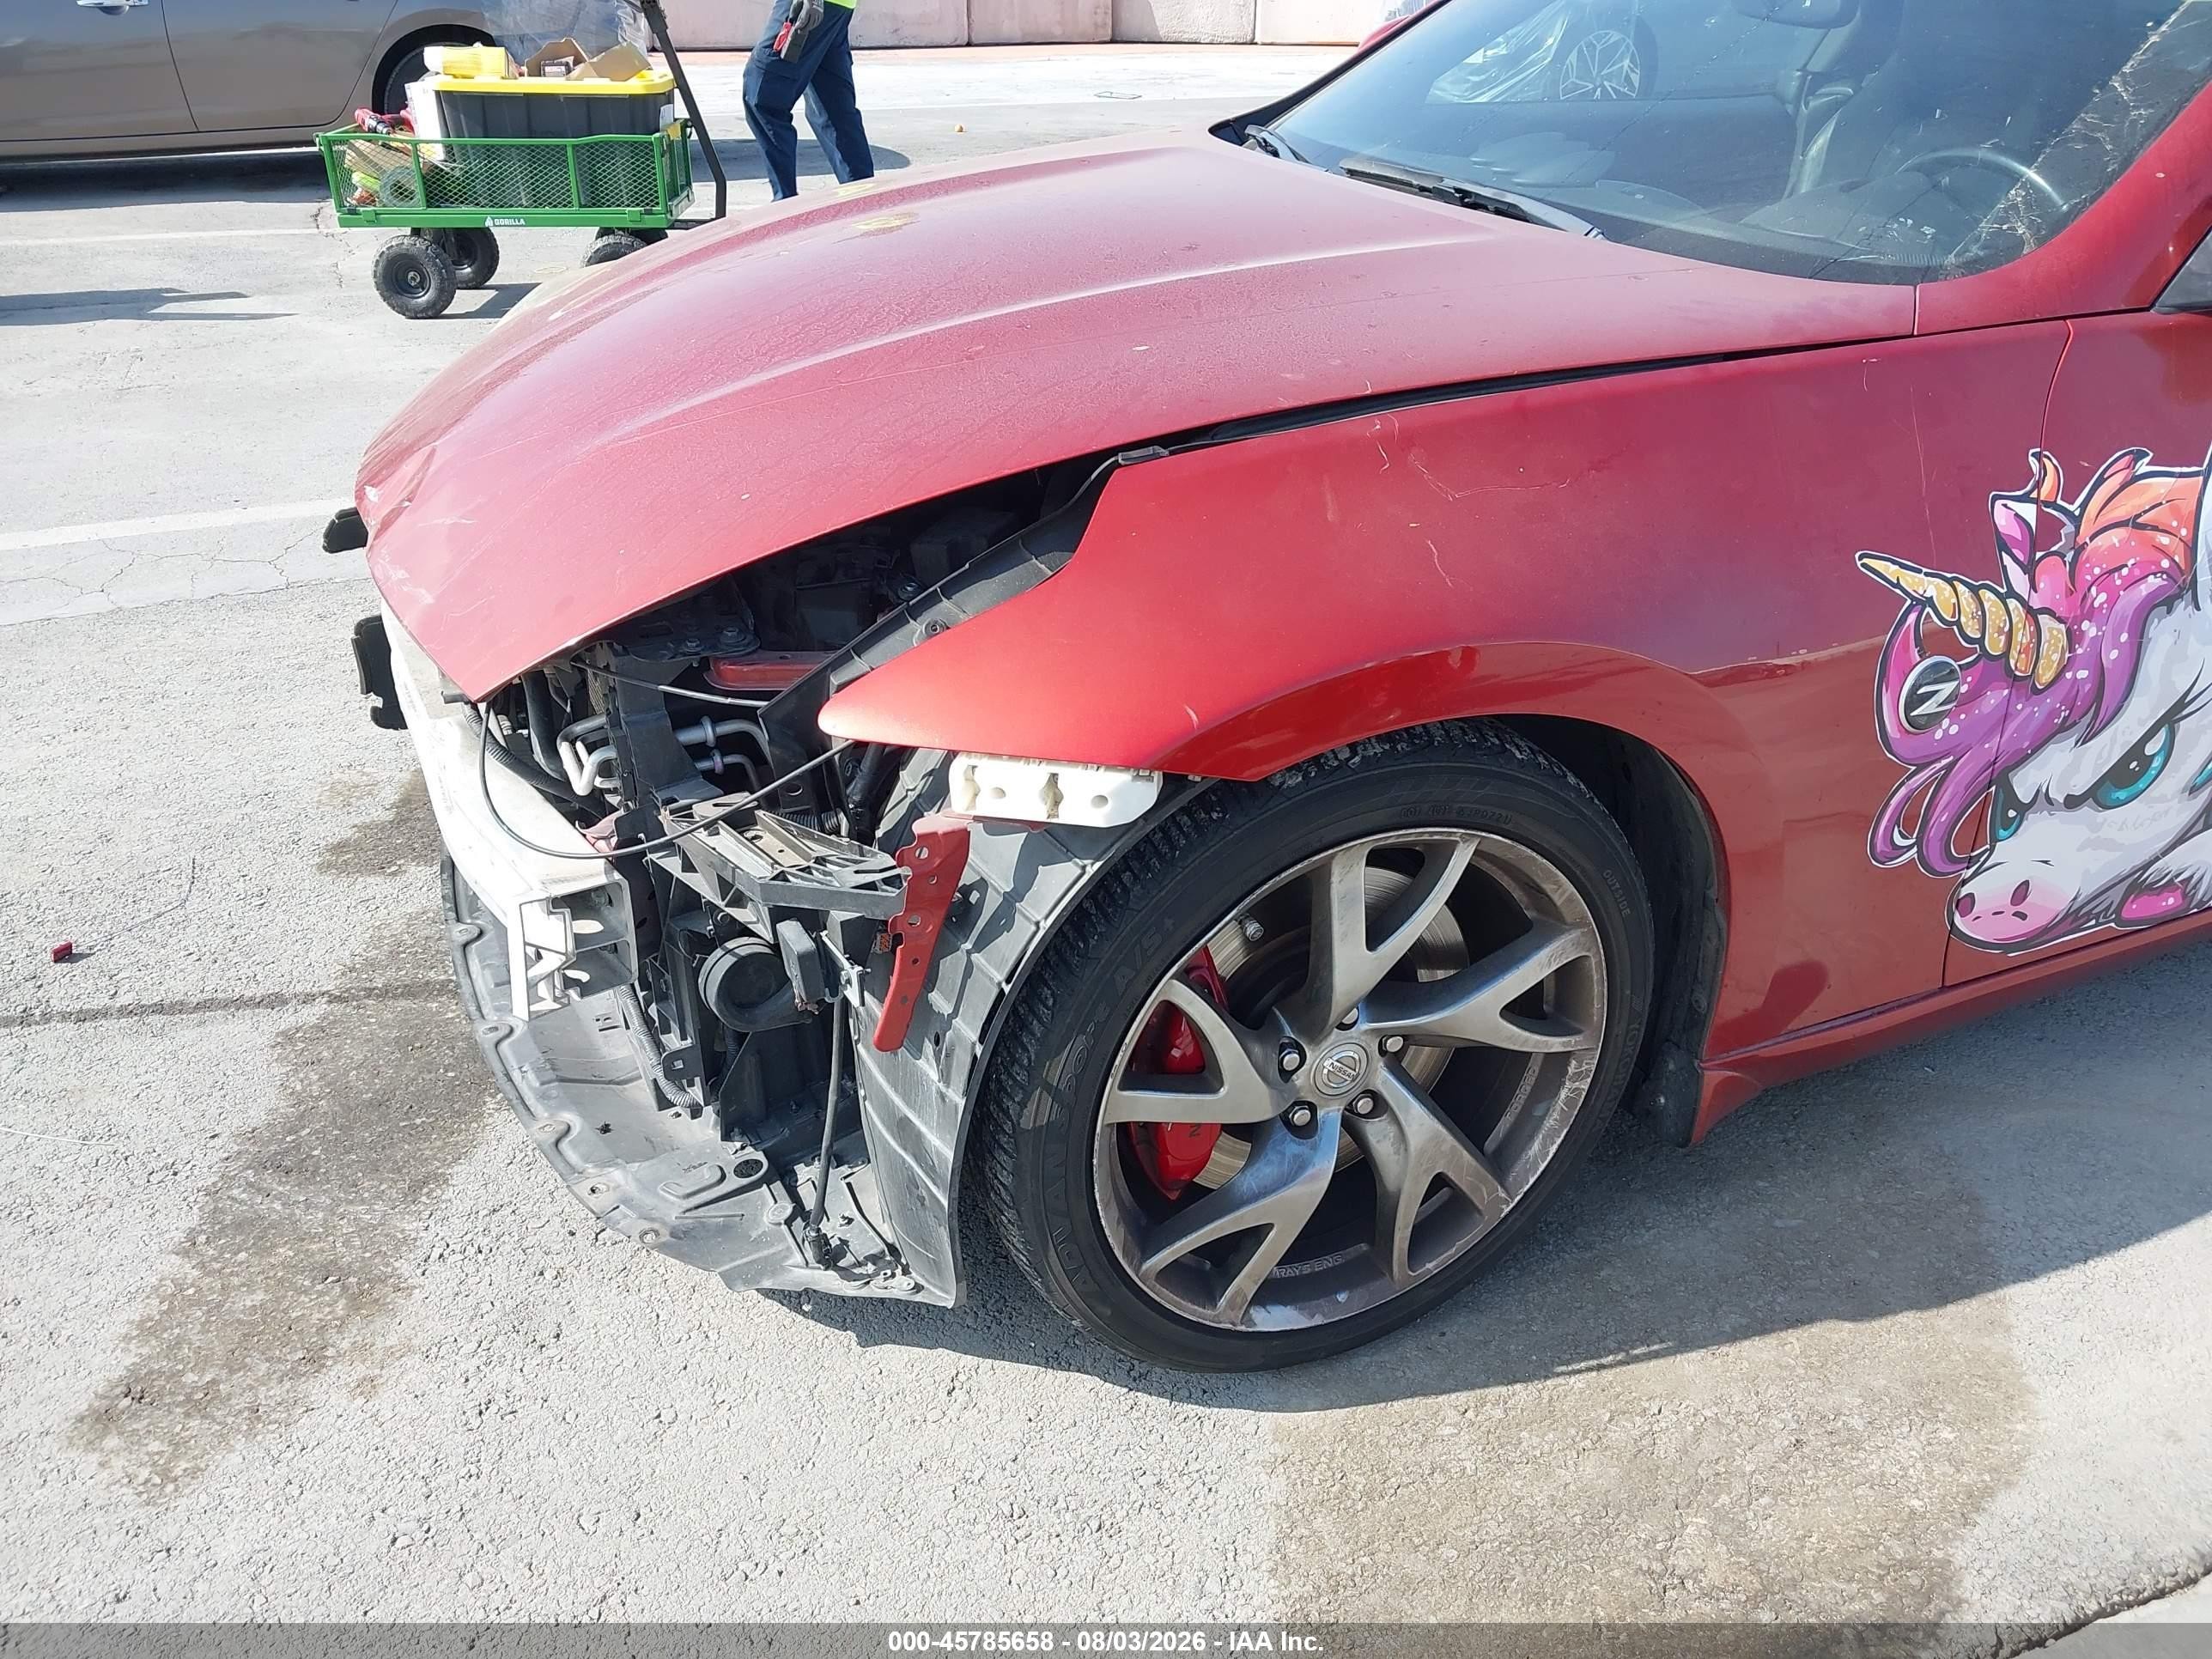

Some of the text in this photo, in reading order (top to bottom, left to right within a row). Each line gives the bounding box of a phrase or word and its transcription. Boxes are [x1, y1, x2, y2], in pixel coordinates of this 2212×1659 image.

[1910, 680, 1959, 716] Z
[1602, 869, 1632, 919] OUTSIDE
[1328, 1060, 1358, 1082] NISSAN
[1504, 1065, 1540, 1121] FORGED
